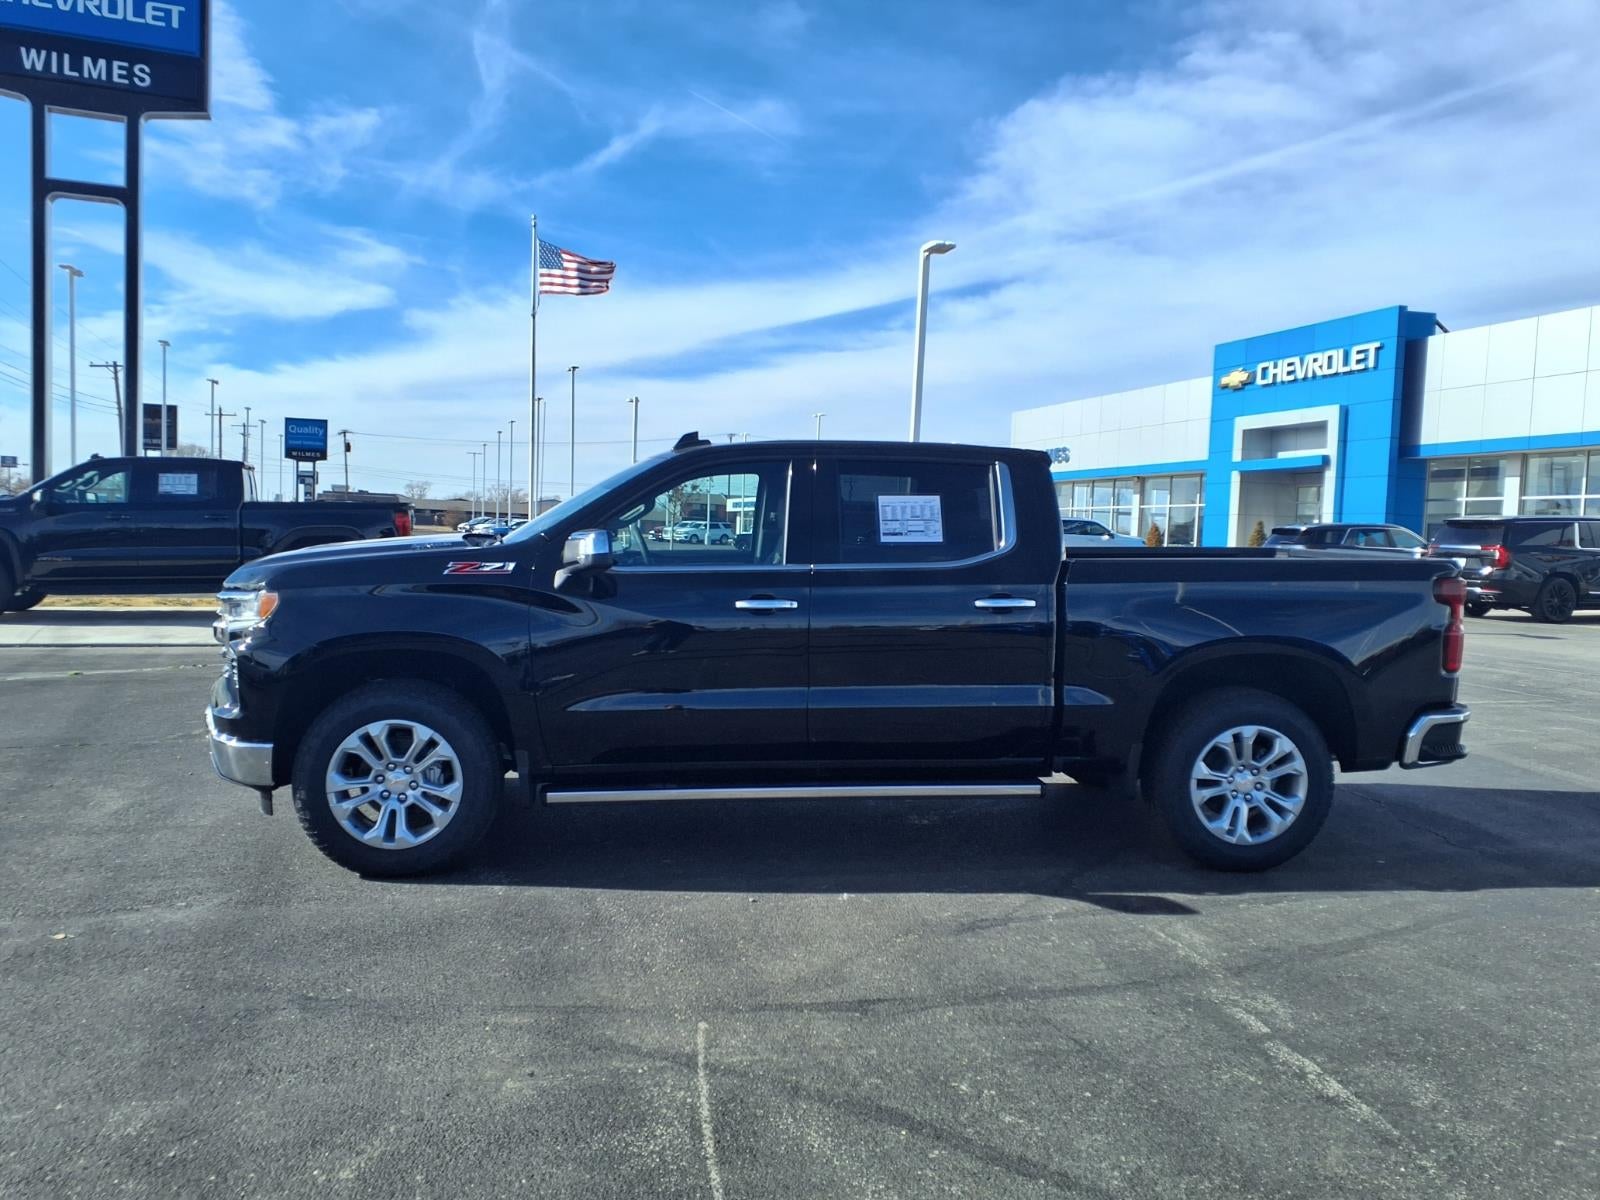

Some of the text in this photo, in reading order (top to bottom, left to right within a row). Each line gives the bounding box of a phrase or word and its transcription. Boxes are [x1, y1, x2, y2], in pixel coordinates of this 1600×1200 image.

[0, 0, 186, 29] ROLET
[19, 46, 151, 87] WILMES
[1255, 341, 1382, 386] CHEVROLET
[288, 424, 324, 437] Quality
[443, 561, 517, 575] Z71
